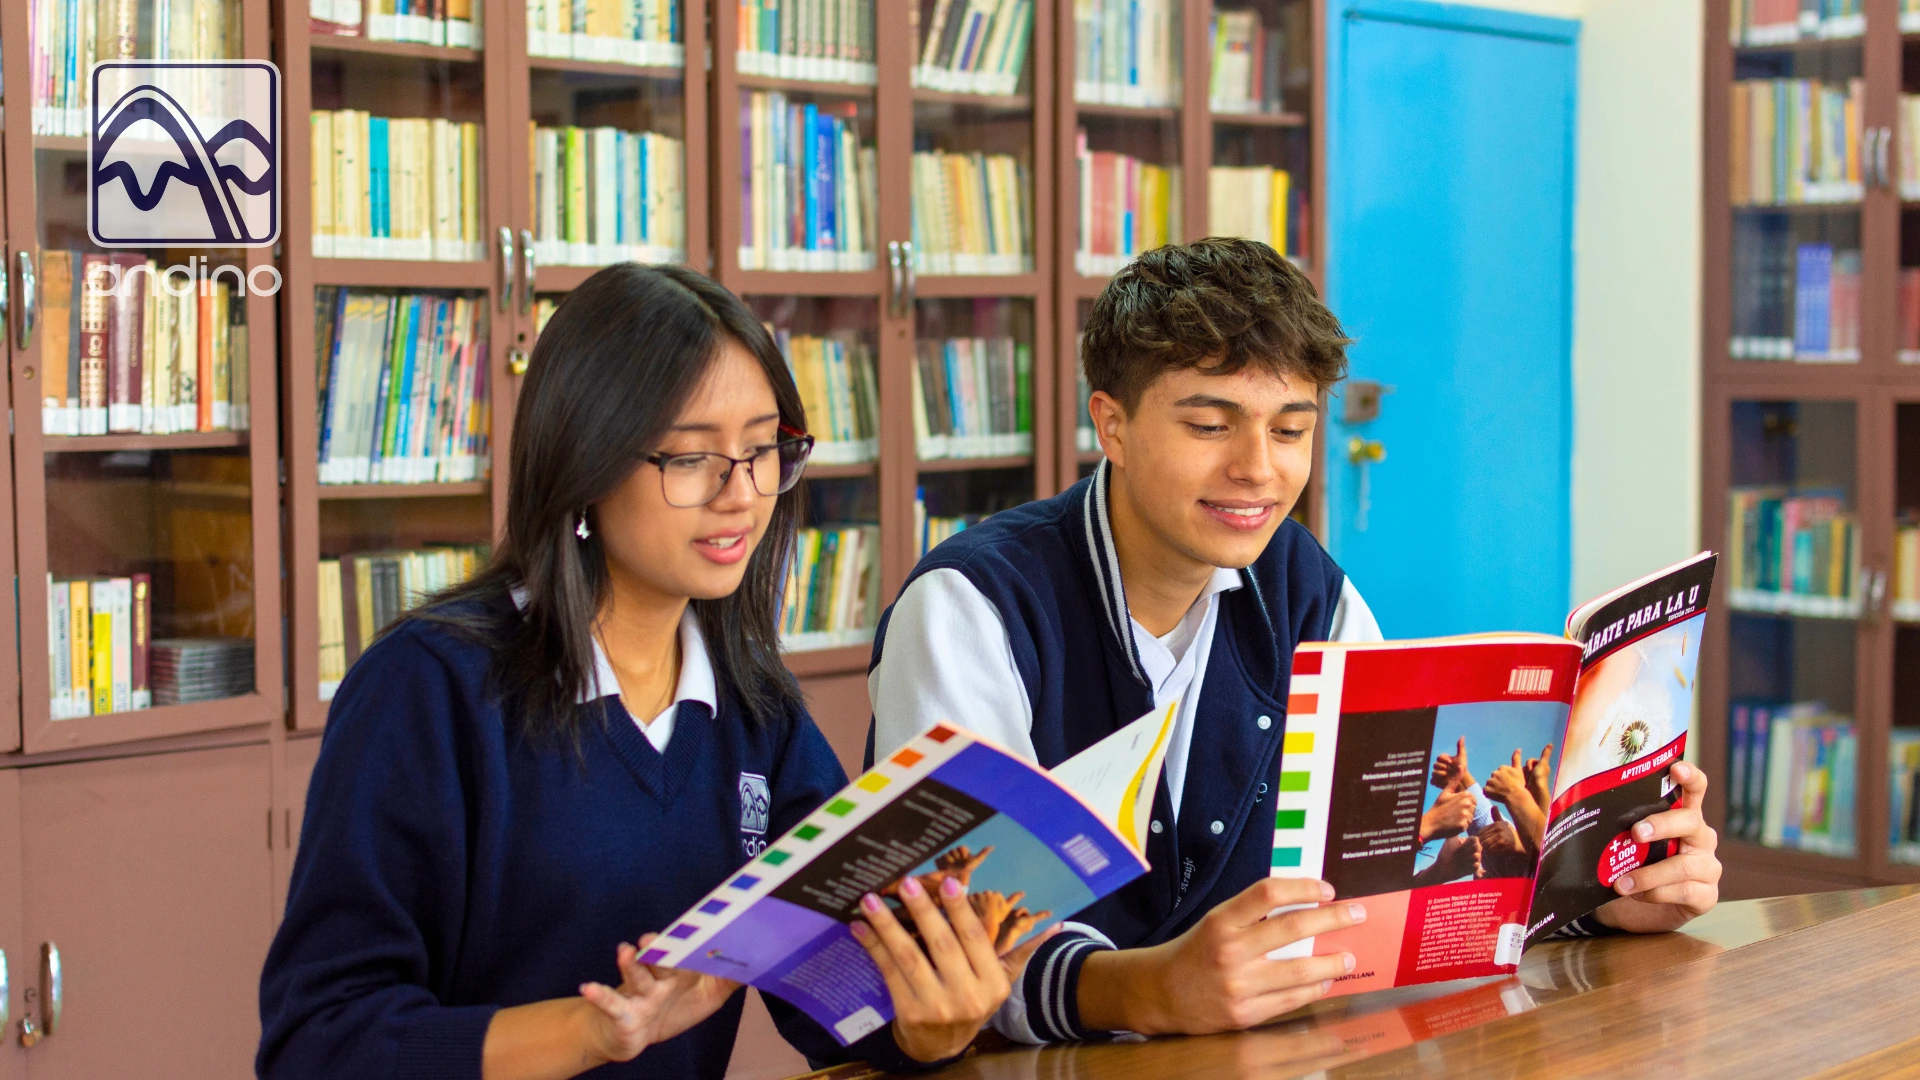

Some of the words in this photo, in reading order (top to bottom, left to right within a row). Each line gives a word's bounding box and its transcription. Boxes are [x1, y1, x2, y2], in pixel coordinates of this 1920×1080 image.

[1626, 601, 1662, 633] PARA
[1665, 591, 1684, 615] LA
[1689, 585, 1700, 605] U
[1621, 762, 1651, 780] APTITUD
[1652, 748, 1674, 768] VERBAL
[1674, 745, 1678, 754] 1
[1610, 856, 1616, 866] 5
[1618, 844, 1636, 861] 000
[1612, 856, 1634, 872] nuevos
[1608, 861, 1640, 883] ejercicios
[1333, 971, 1375, 982] SANTILLANA
